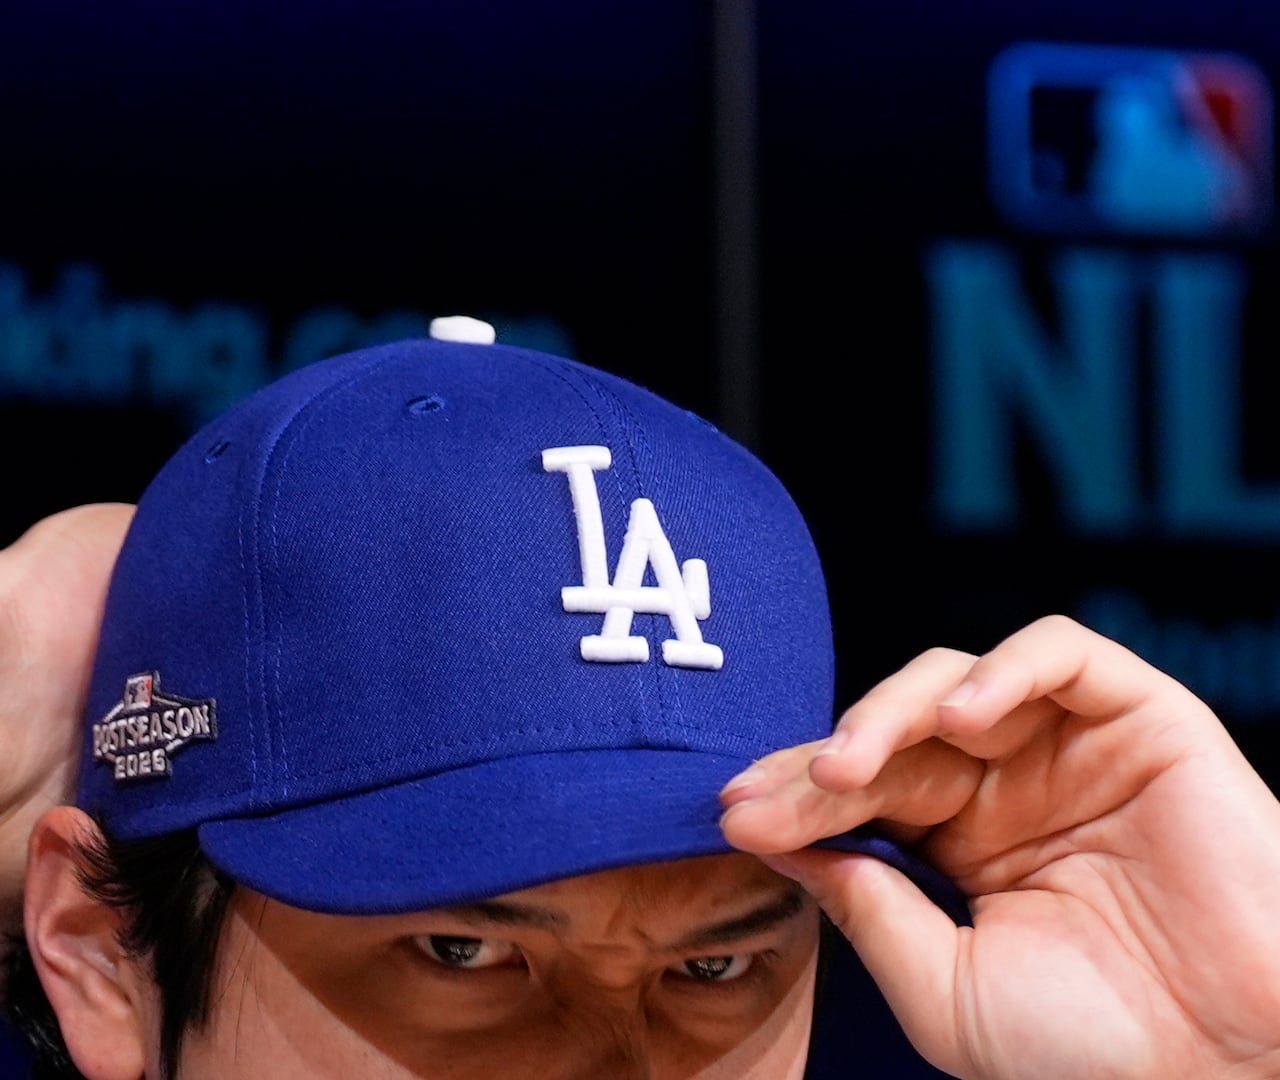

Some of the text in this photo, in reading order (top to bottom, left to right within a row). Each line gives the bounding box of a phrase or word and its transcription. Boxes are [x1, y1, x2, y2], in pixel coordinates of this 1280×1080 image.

[542, 445, 723, 669] LA
[93, 704, 211, 757] POSTSEASON
[115, 747, 166, 779] 2026
